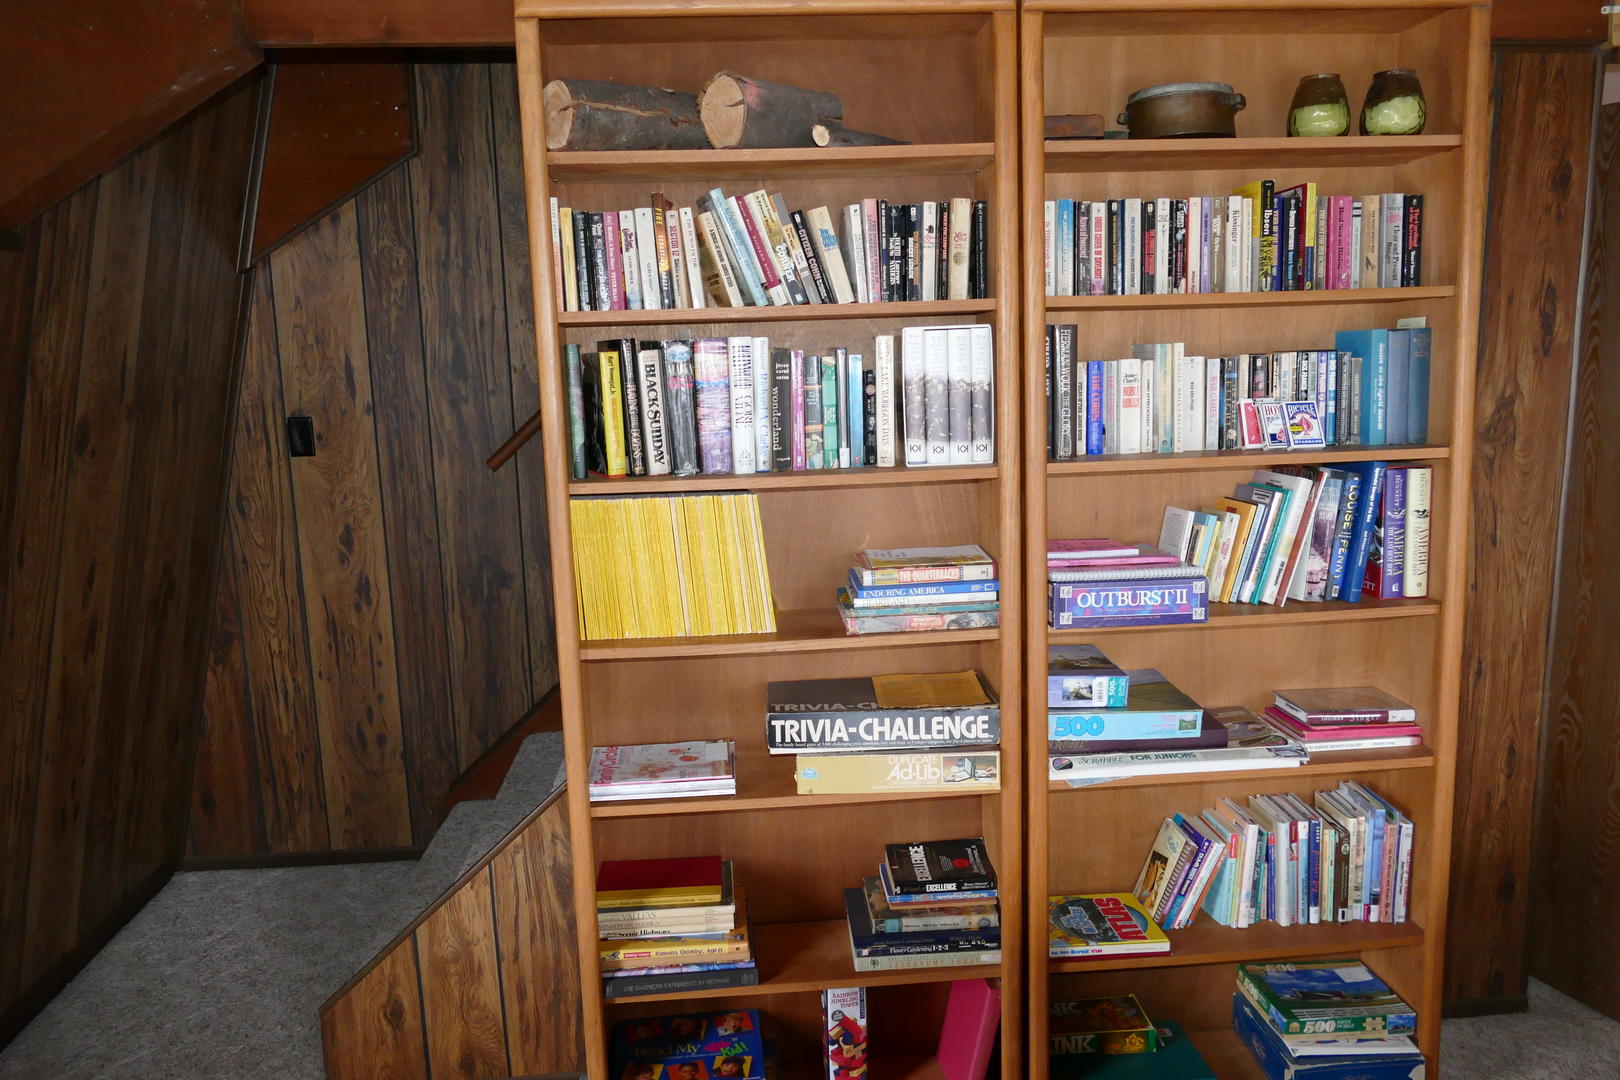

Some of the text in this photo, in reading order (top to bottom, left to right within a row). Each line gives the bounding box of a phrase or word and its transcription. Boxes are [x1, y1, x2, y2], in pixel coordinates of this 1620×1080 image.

[1094, 217, 1102, 233] UNDER
[1231, 210, 1240, 243] Kissinger
[1264, 209, 1272, 235] Ibsen
[670, 226, 679, 249] SECTOR
[798, 229, 814, 258] CITIZEN
[1094, 234, 1102, 249] COVER
[775, 245, 795, 282] CORNER
[1392, 225, 1400, 281] Clear and Present
[1094, 257, 1102, 279] DAYLIGHT
[1061, 329, 1071, 366] HERMAN
[1061, 366, 1071, 393] WOUK
[1091, 375, 1101, 391] THE
[627, 384, 637, 415] PLAYING
[1288, 404, 1316, 417] BICYCLE
[1377, 388, 1385, 407] April
[645, 364, 665, 465] BLACK SUNDAY
[735, 395, 744, 428] VIDAL
[744, 395, 753, 428] GORE
[760, 373, 769, 457] Richard Clarke
[772, 387, 781, 451] wonderland
[1061, 408, 1072, 437] GLORY
[630, 429, 642, 459] DOZENS
[883, 428, 891, 446] DAYS
[1370, 486, 1378, 501] Savage
[1419, 473, 1427, 506] BENNETT
[1334, 485, 1359, 579] LOUISE PENNY
[1394, 528, 1404, 576] AMERICA
[1417, 528, 1428, 576] AMERICA
[900, 571, 911, 582] THE
[863, 586, 945, 598] ENDURING AMERICA
[1077, 589, 1188, 608] OUTBURST II
[771, 715, 989, 743] TRIVIA-CHALLENGE
[1054, 716, 1105, 737] 500
[888, 756, 938, 765] DUPLICATE
[1080, 756, 1123, 765] SCRABBLE
[1152, 752, 1197, 761] JUNIORS
[909, 845, 933, 882] EXCELLENCE
[926, 883, 957, 892] EXCELLENCE
[621, 912, 657, 921] VALLEYS
[1093, 897, 1149, 941] ATLAS
[634, 983, 663, 992] AMERICAN
[1303, 1021, 1336, 1034] 500
[676, 1043, 700, 1054] My
[720, 1041, 749, 1057] Kid!
